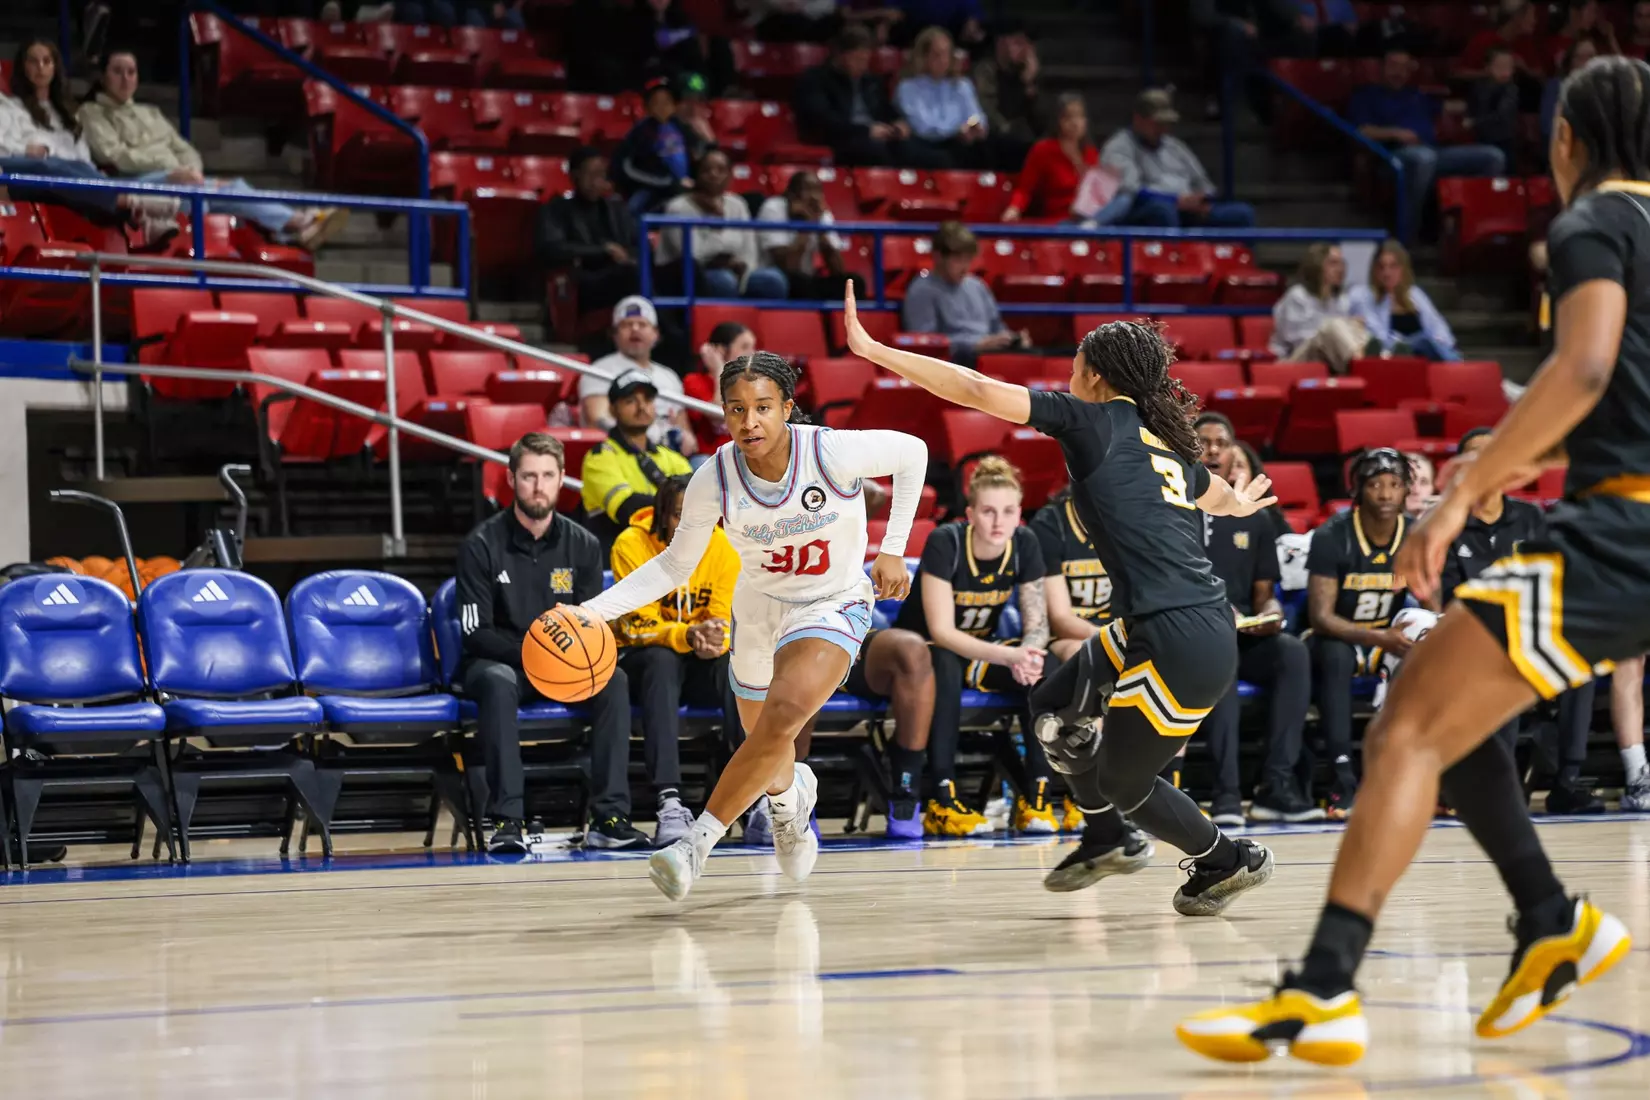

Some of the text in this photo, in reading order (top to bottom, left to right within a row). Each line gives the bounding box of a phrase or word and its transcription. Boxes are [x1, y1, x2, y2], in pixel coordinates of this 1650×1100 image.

[1148, 453, 1196, 510] 3
[774, 512, 839, 538] Techsters
[761, 539, 831, 576] 30
[1070, 576, 1113, 606] 45
[1353, 591, 1395, 621] 21
[960, 607, 992, 629] 11
